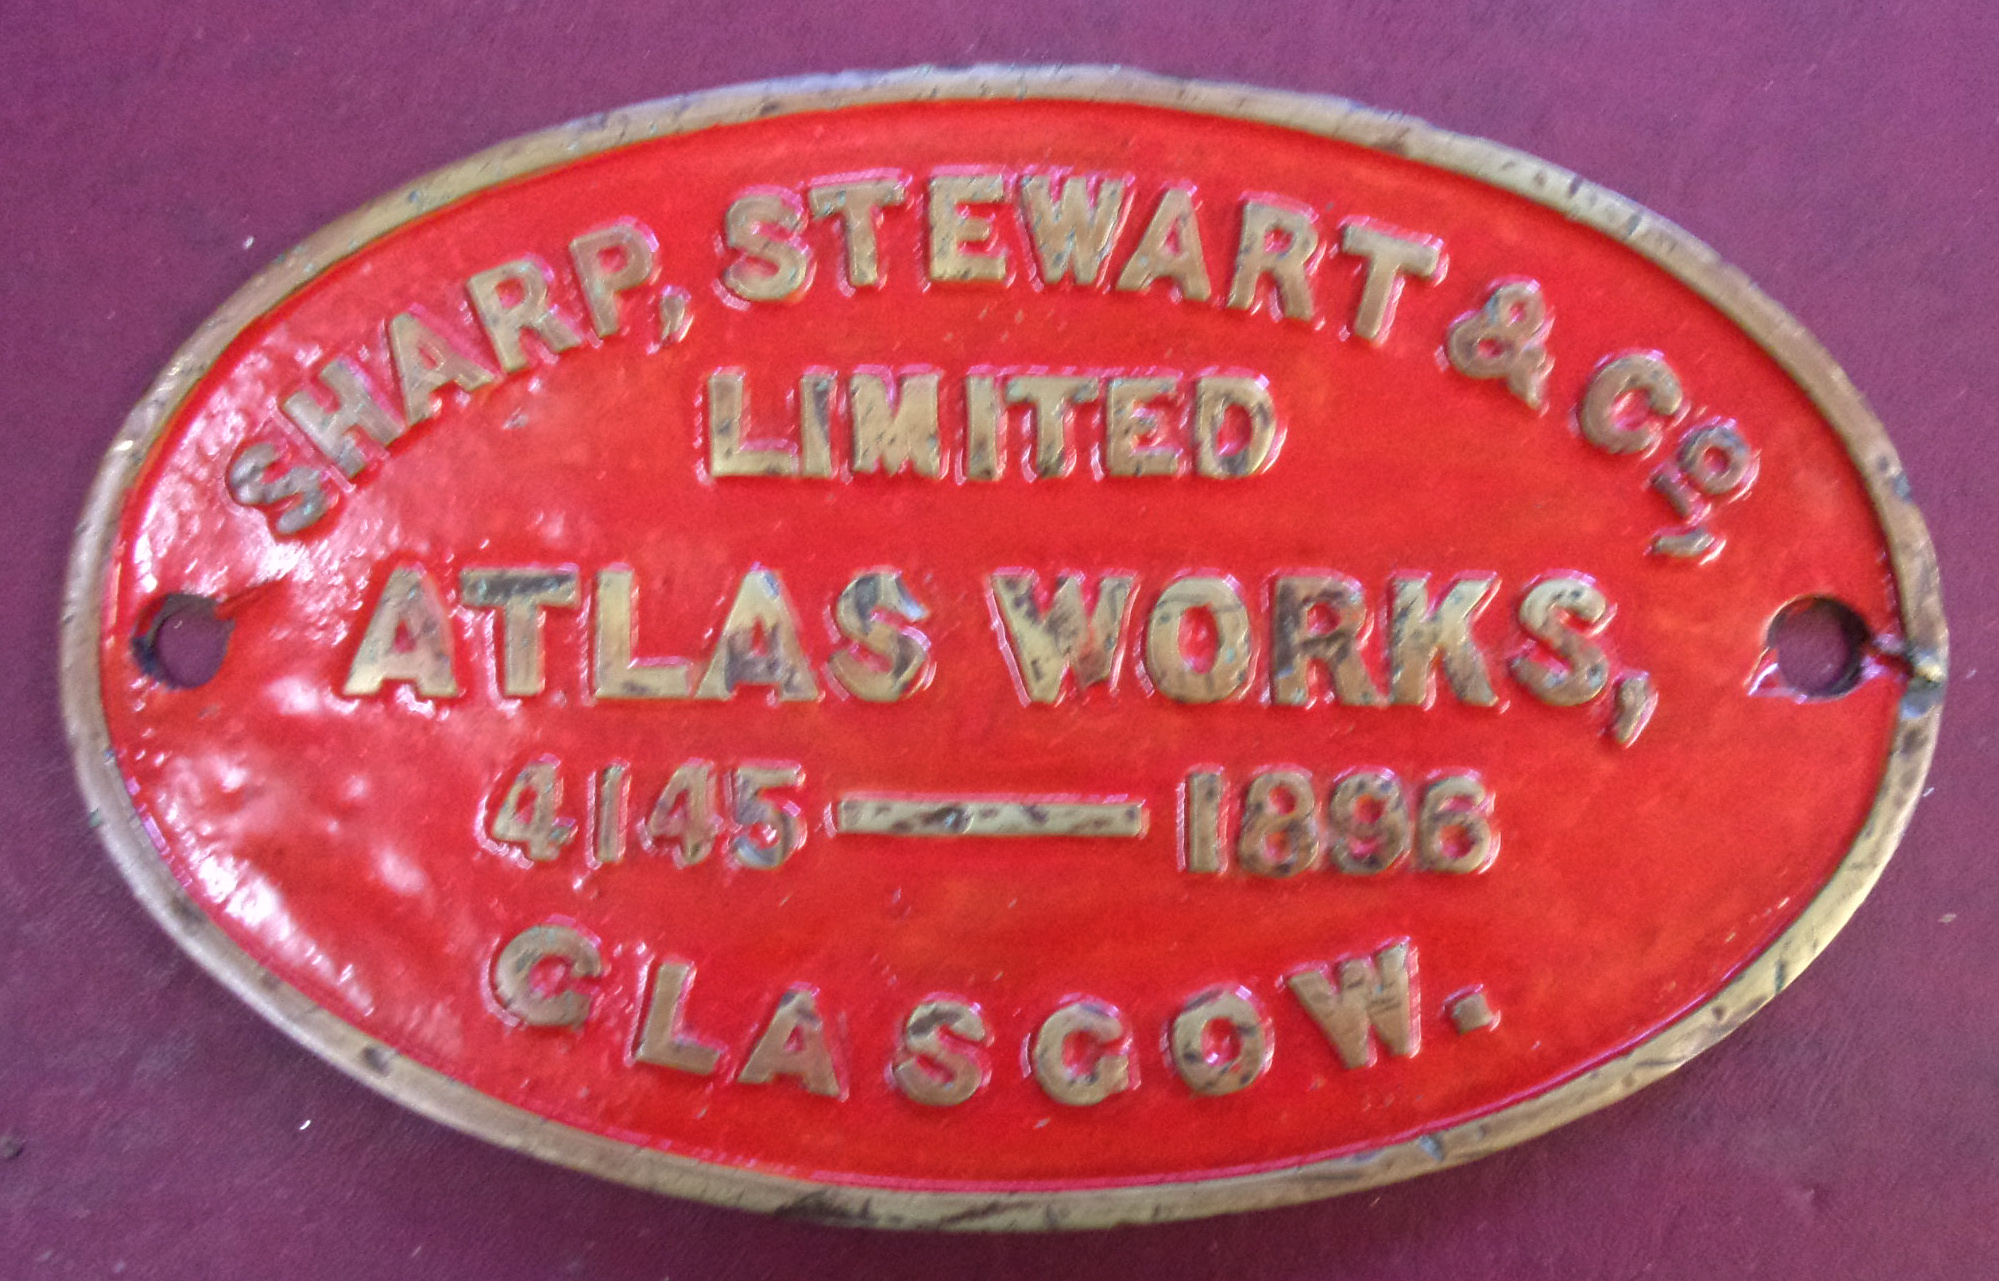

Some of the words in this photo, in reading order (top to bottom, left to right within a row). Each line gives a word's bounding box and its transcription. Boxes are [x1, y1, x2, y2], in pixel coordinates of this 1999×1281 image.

[226, 220, 690, 536] SHARP,
[722, 168, 1446, 342] STEWART
[1446, 280, 1552, 412] &
[702, 370, 1280, 480] LIMITED
[342, 564, 932, 702] ATLAS
[988, 570, 1656, 748] WORKS,
[484, 756, 808, 870] 4145
[1176, 766, 1500, 876] 1896
[490, 922, 1500, 1108] GLASGOW.
